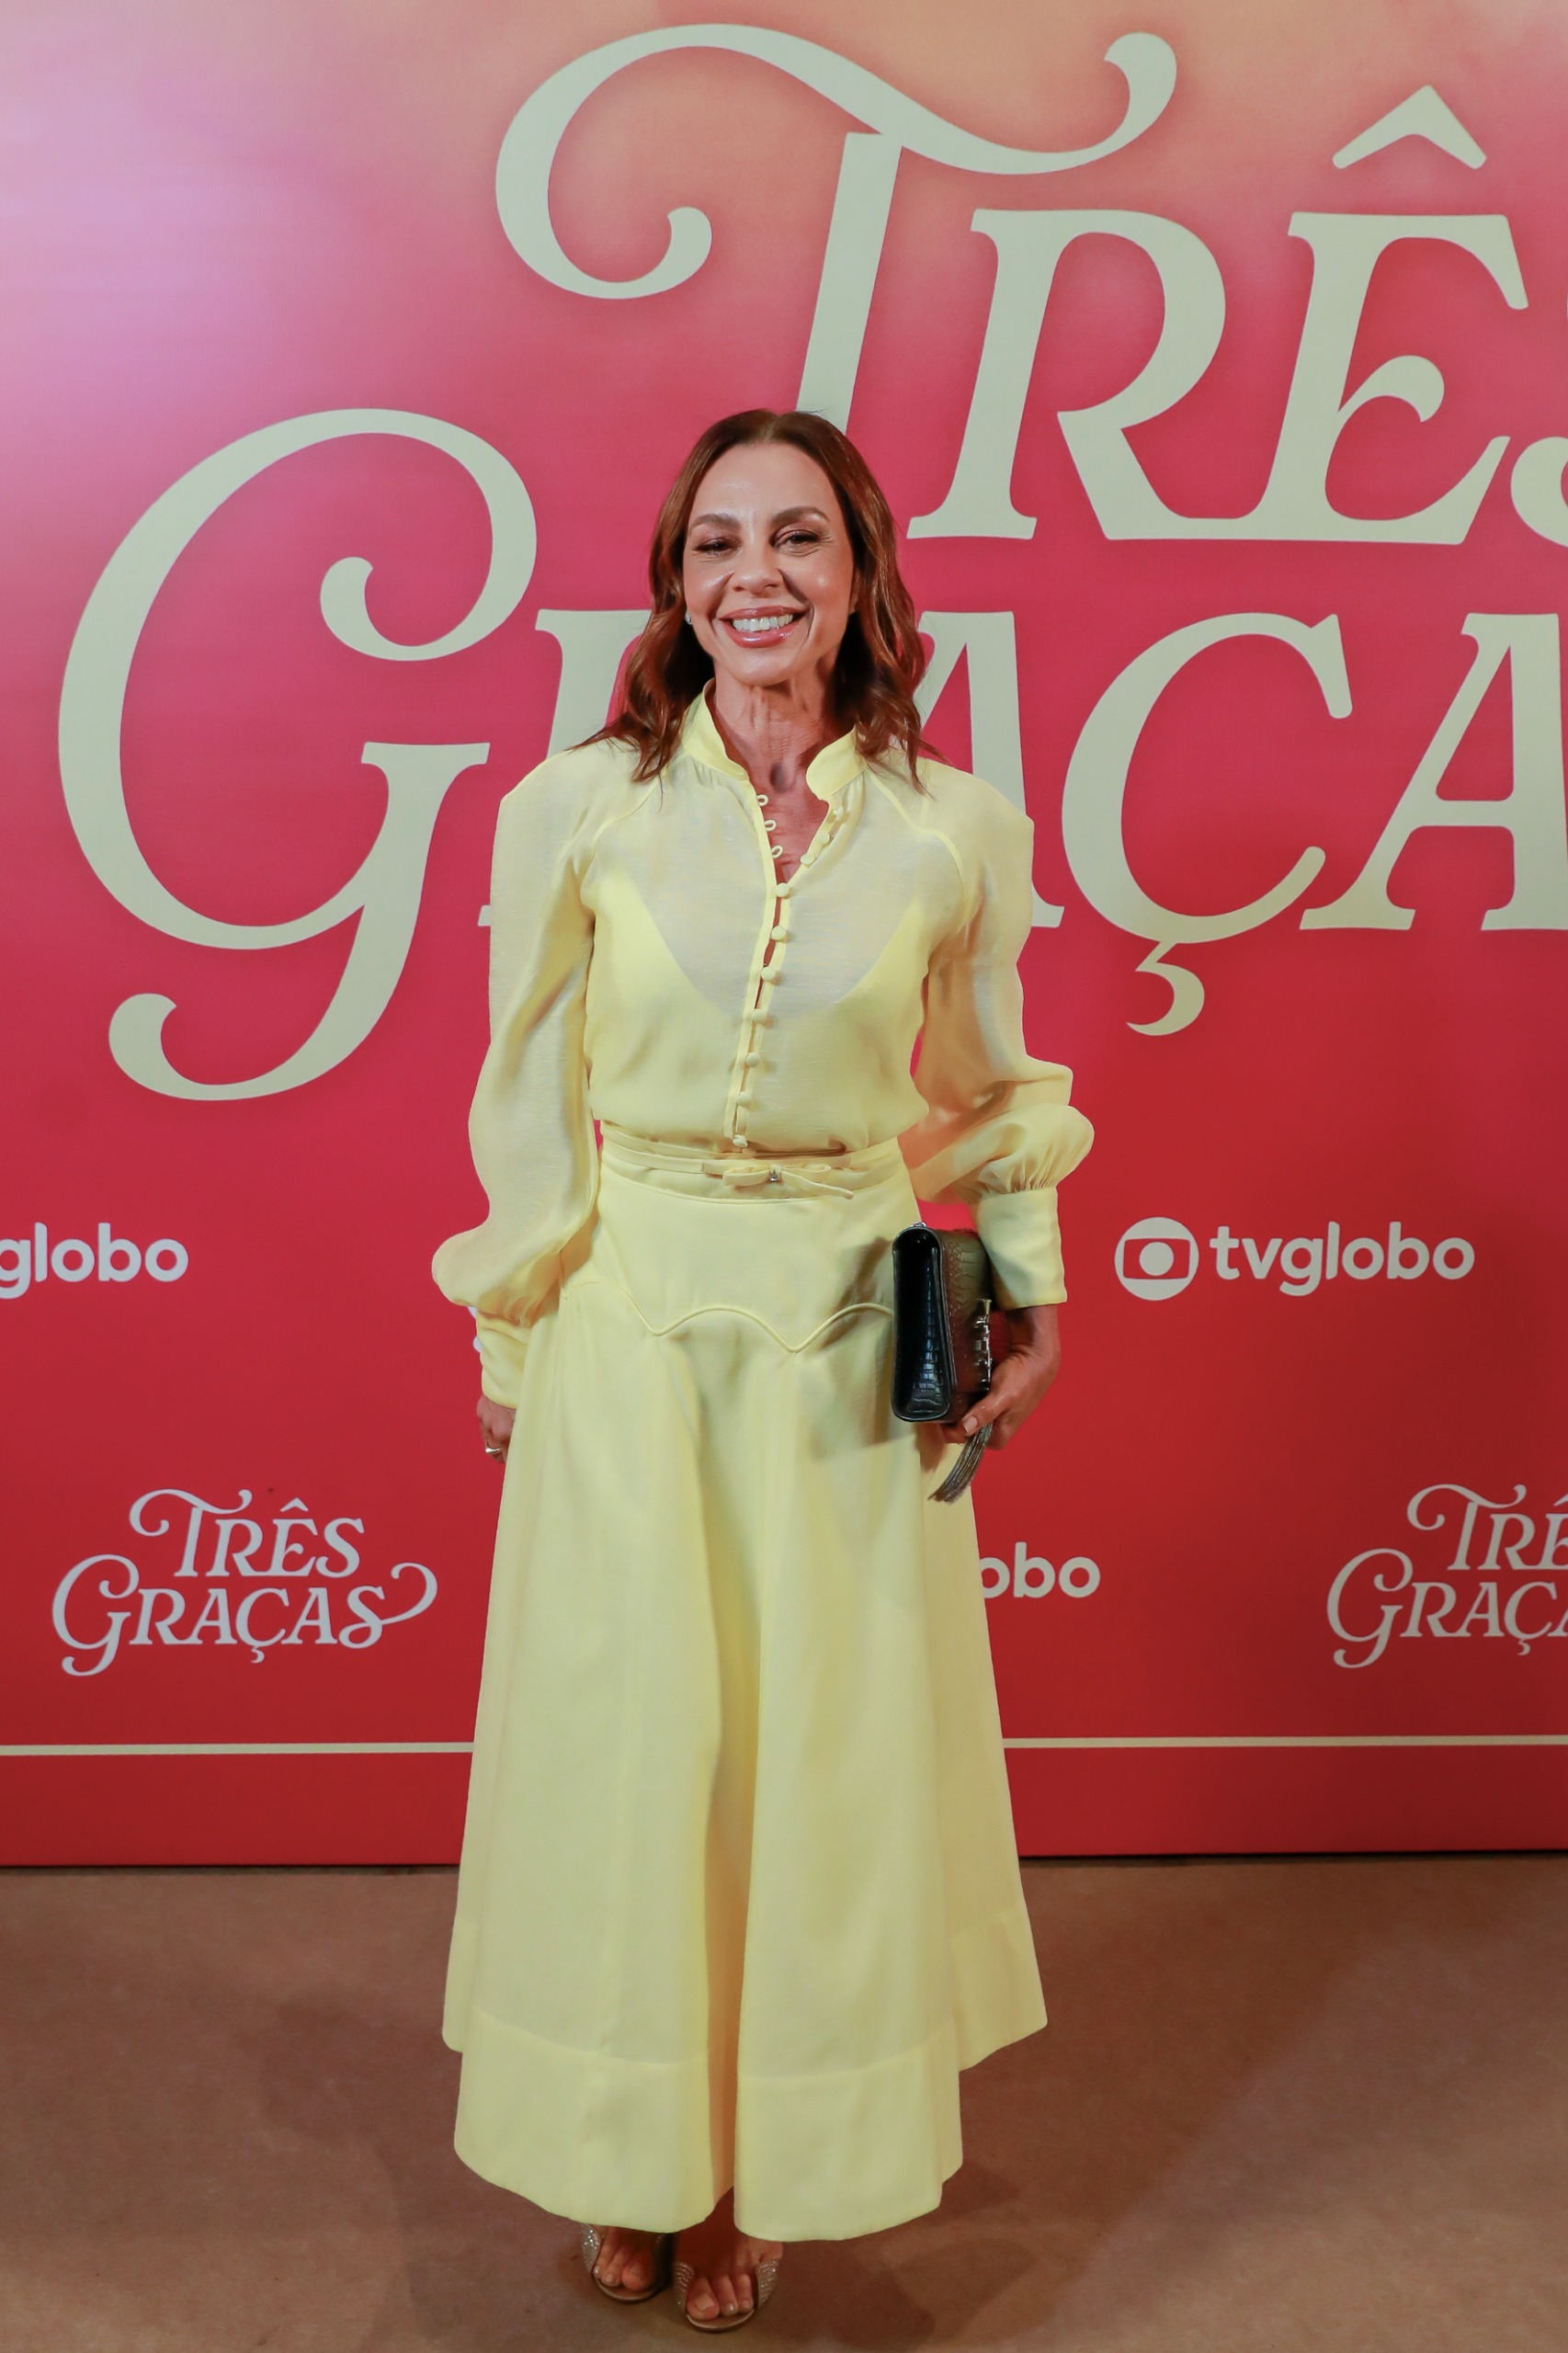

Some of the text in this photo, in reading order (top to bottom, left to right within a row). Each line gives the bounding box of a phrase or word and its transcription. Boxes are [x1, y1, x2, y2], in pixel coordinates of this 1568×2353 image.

[495, 23, 1568, 548] TRÊ
[1210, 1222, 1475, 1297] tvglobo
[130, 1489, 364, 1577] TRÊS
[52, 1554, 437, 1676] GRAÇAS
